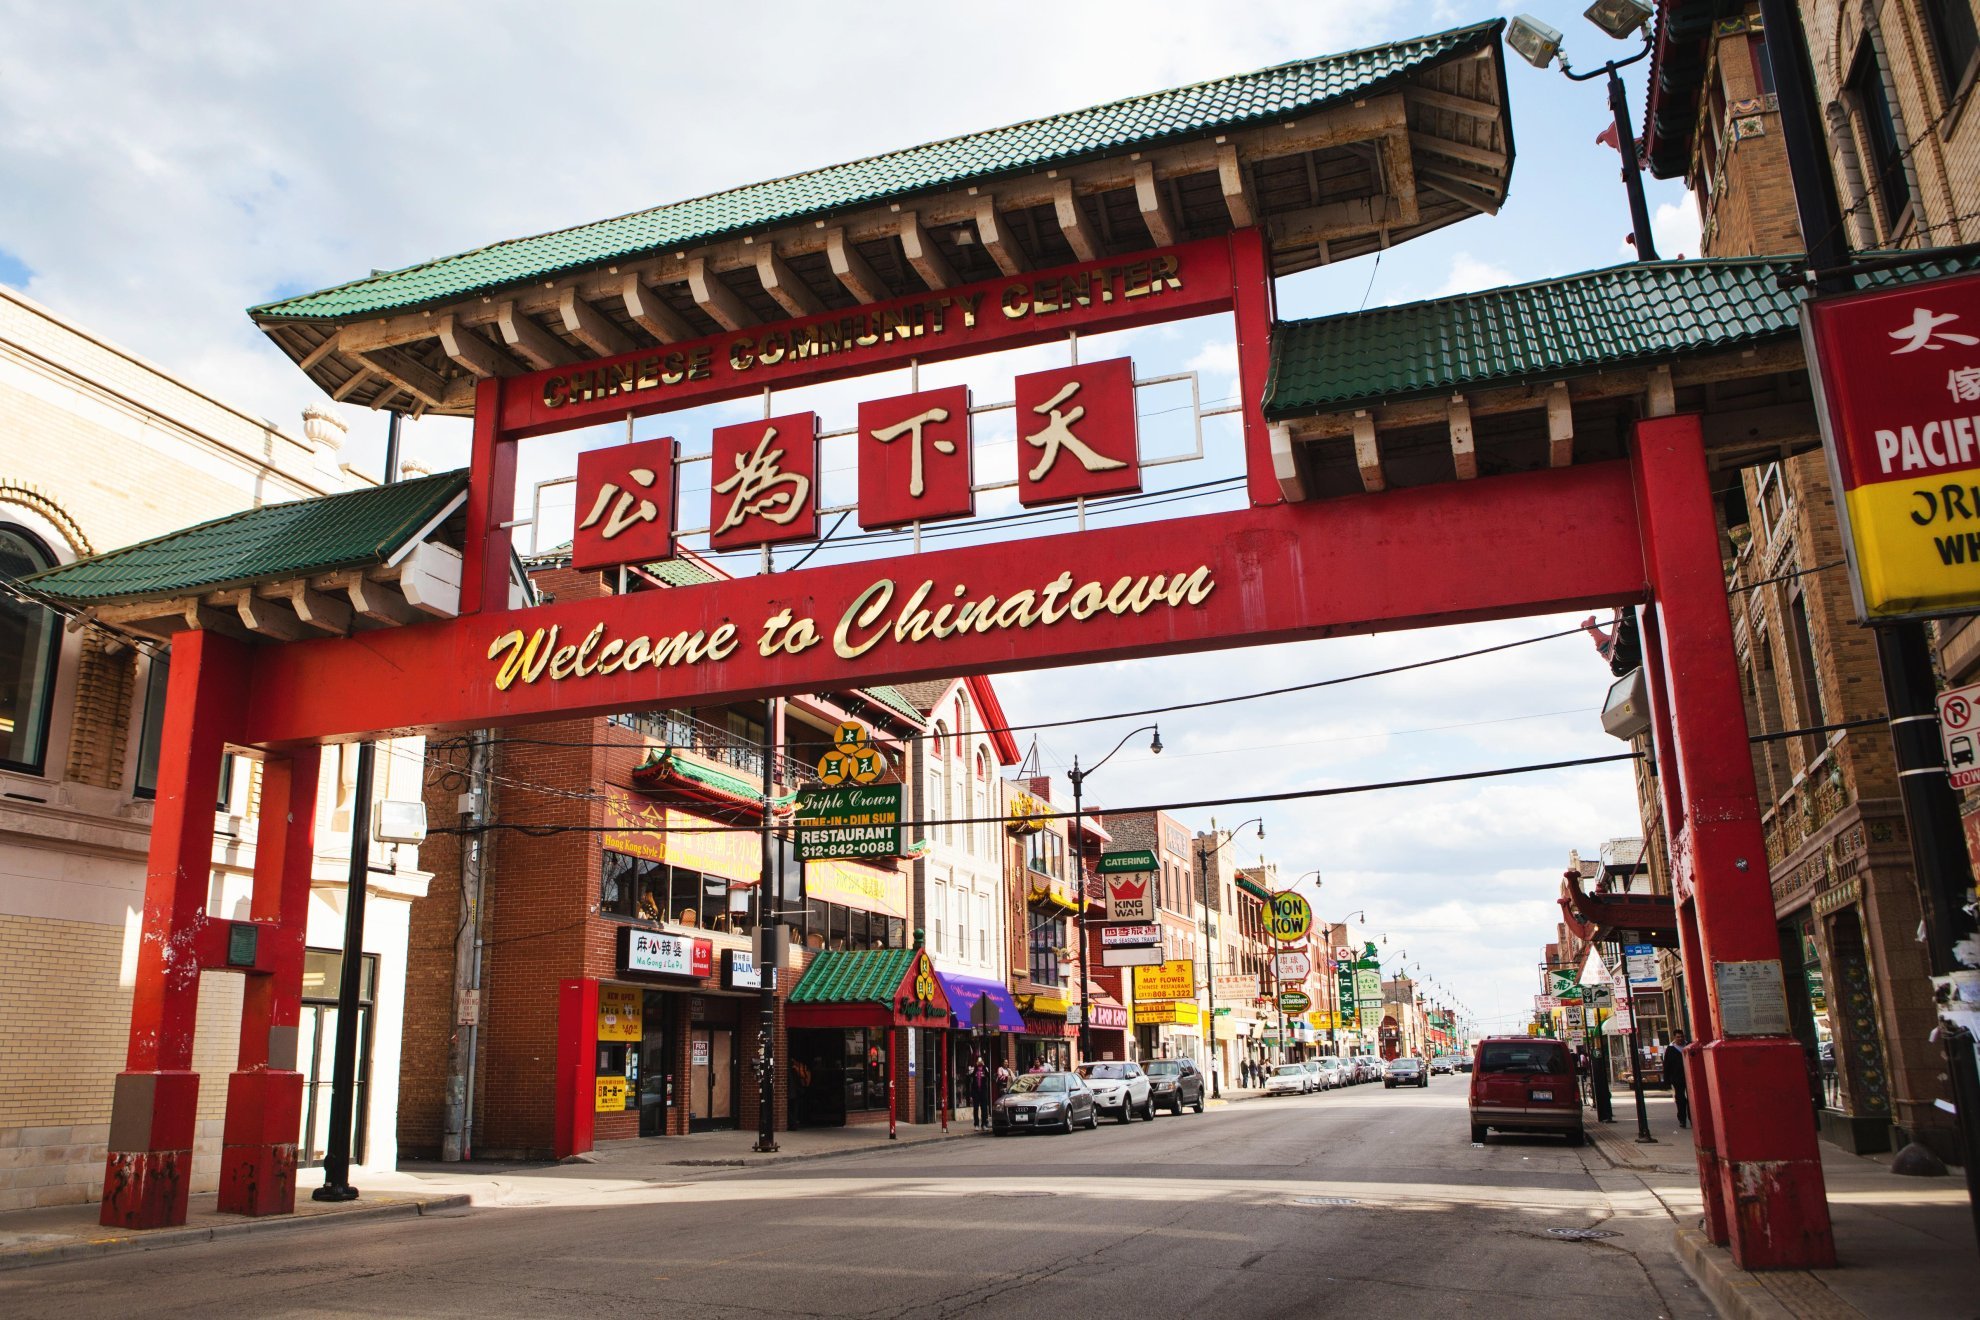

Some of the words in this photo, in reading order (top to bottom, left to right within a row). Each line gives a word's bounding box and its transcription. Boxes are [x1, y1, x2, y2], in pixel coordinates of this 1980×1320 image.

[543, 345, 712, 409] CHINESE
[729, 292, 984, 371] COMMUNITY
[1001, 254, 1183, 319] CENTER
[1888, 307, 1980, 356] 太
[487, 621, 740, 692] Welcome
[758, 607, 822, 658] to
[832, 564, 1216, 660] Chinatown
[803, 793, 844, 816] Triple
[848, 790, 897, 808] Crown
[849, 814, 870, 826] DIM
[872, 812, 896, 824] SUM
[801, 826, 895, 845] RESTAURANT
[605, 834, 624, 851] Hong
[624, 839, 642, 855] Kong
[643, 843, 659, 858] Style
[801, 841, 895, 858] 312-842-0088
[1104, 856, 1150, 867] CATERING
[1114, 900, 1143, 909] KING
[1114, 908, 1144, 917] WAH
[1270, 899, 1303, 916] WON
[1271, 917, 1304, 934] KOW
